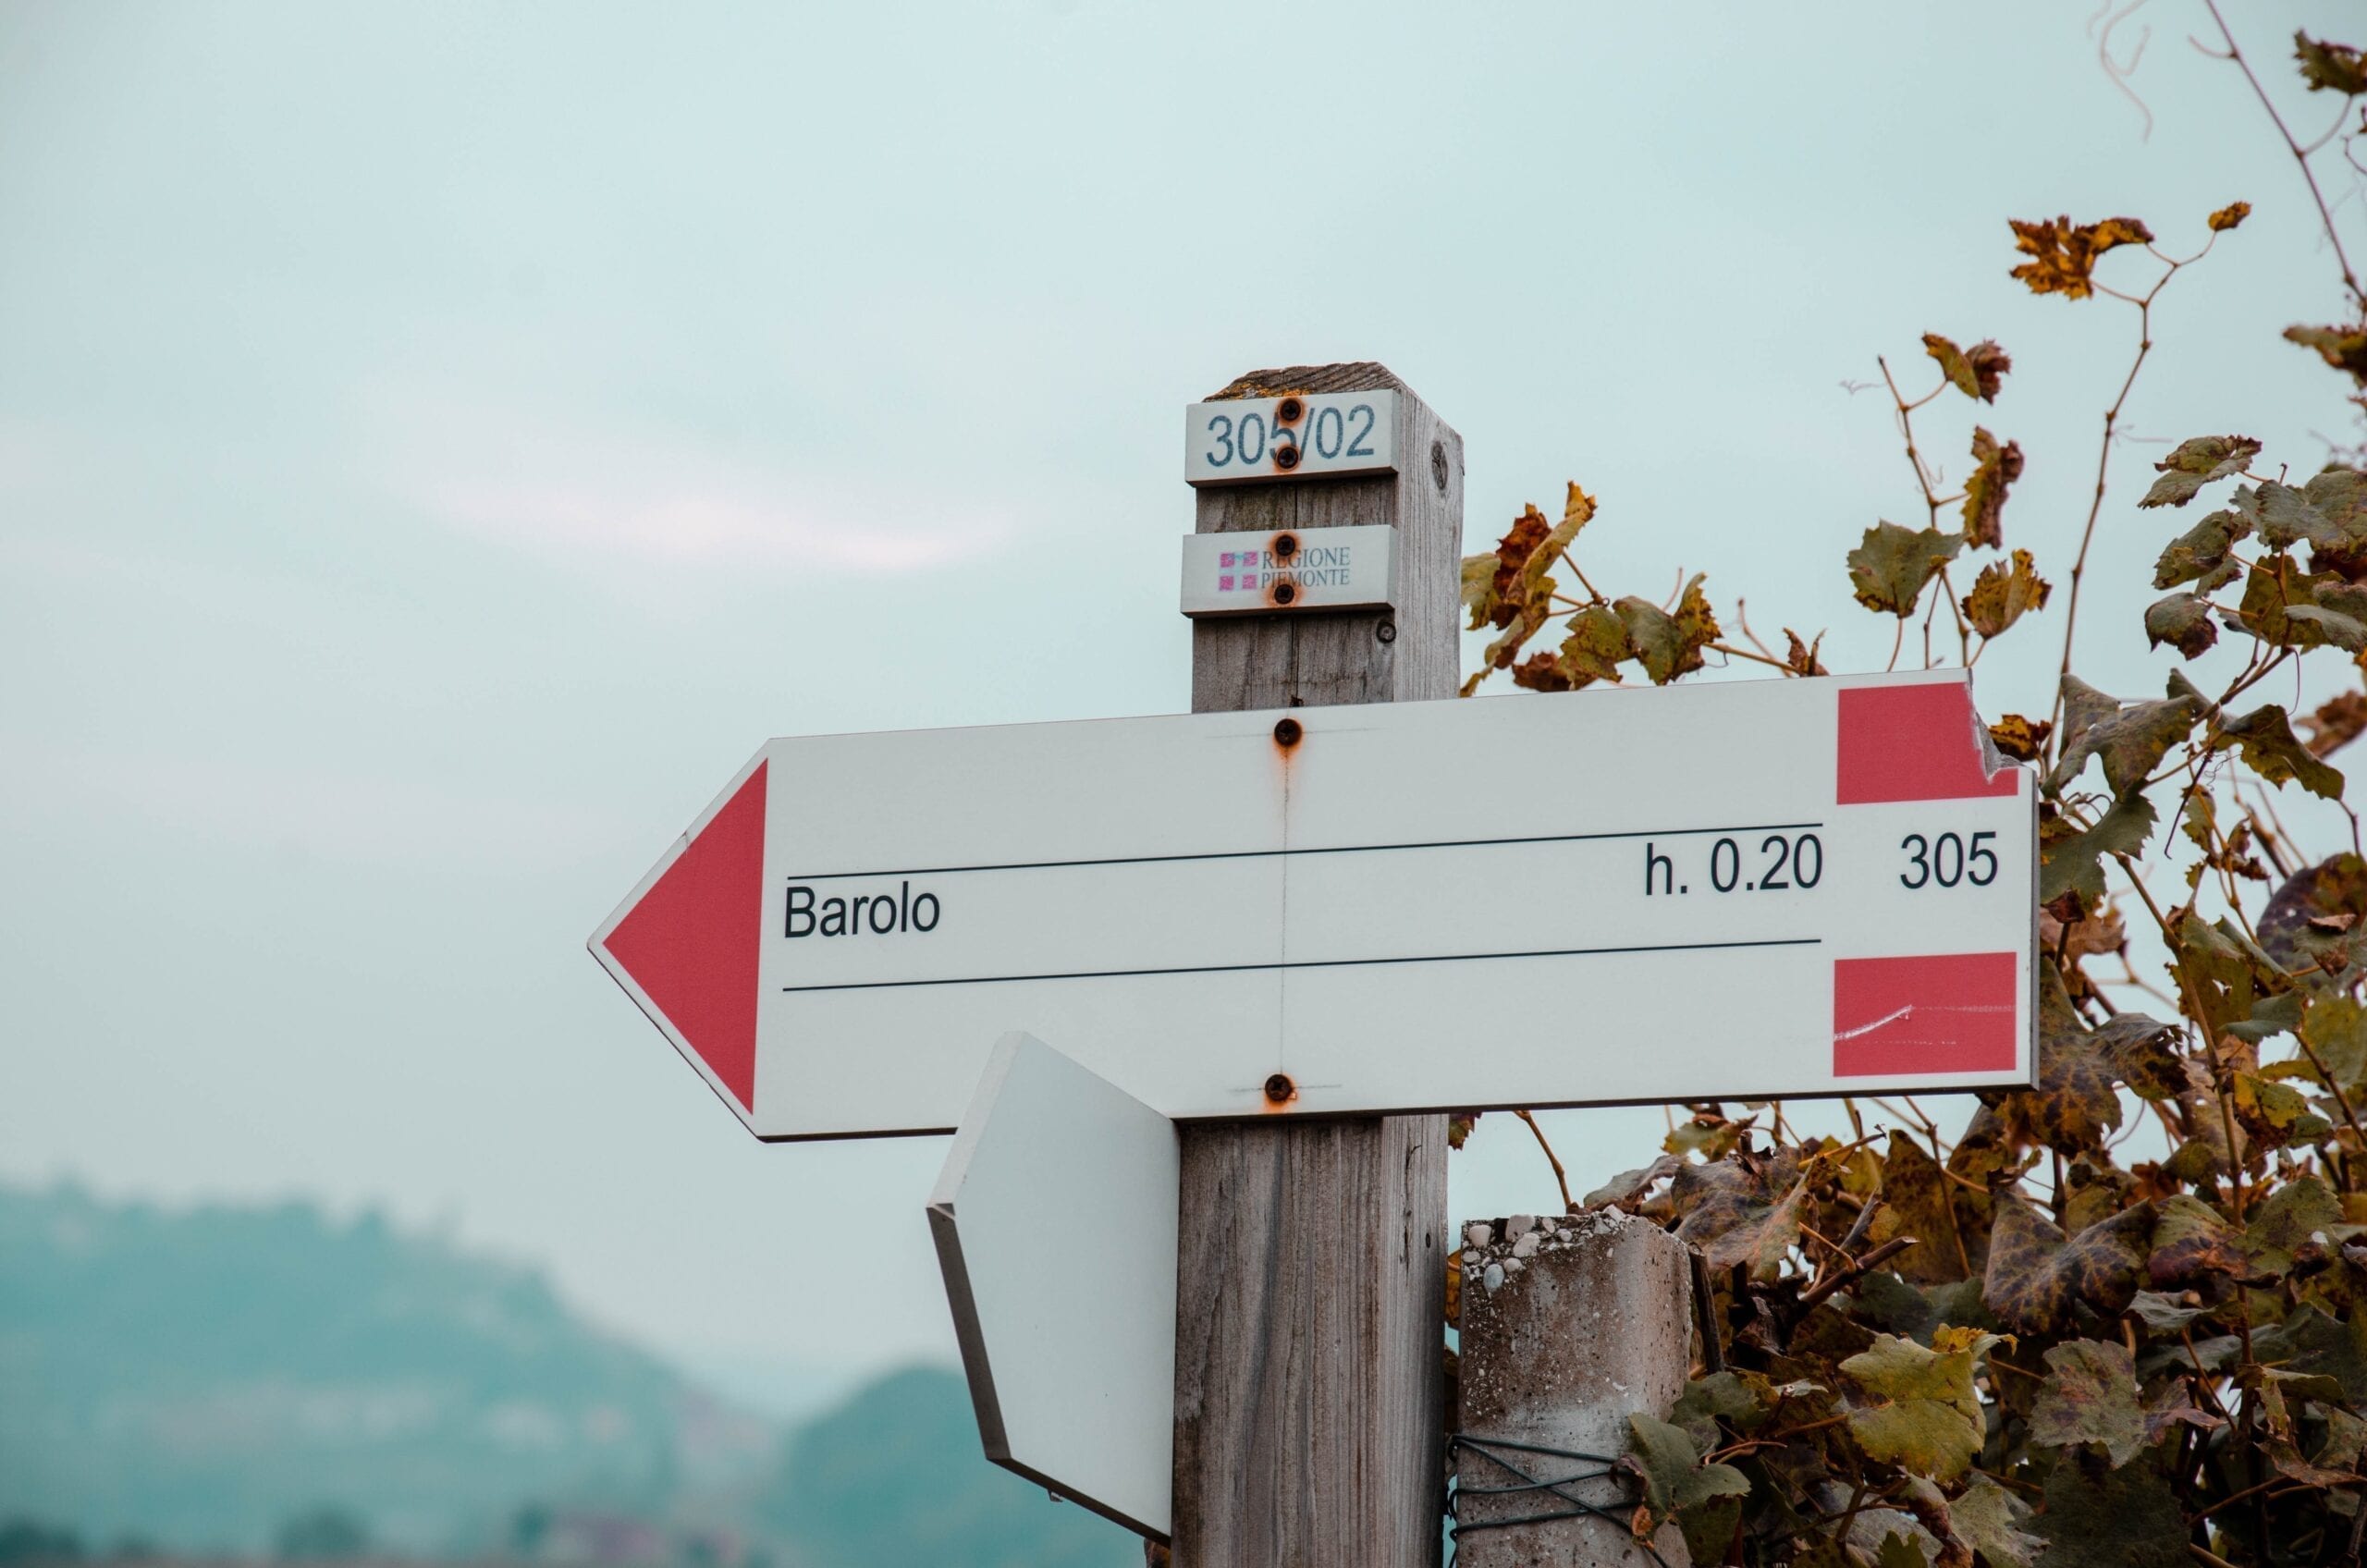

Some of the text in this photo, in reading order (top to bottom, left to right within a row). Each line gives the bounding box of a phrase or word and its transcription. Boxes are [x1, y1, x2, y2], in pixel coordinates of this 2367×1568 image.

[1645, 833, 1823, 896] h. 0.20
[1900, 830, 1999, 889] 305
[784, 880, 940, 938] Barolo
